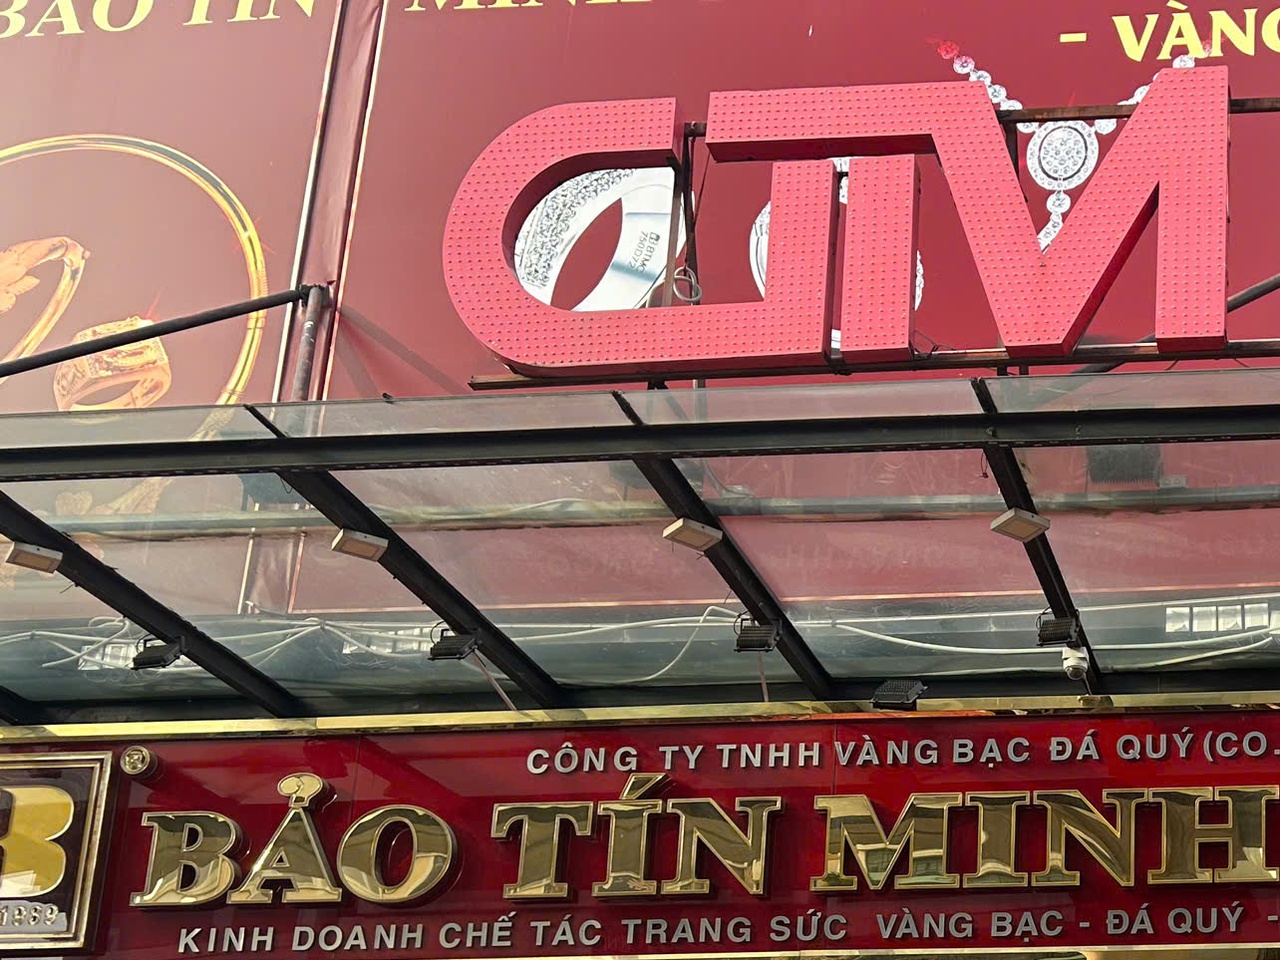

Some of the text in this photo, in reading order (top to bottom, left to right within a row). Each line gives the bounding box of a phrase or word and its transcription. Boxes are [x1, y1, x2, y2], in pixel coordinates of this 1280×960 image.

[526, 741, 639, 774] CÔNG
[659, 744, 704, 771] TY
[716, 741, 821, 769] TNHH
[835, 733, 939, 766] VÀNG
[953, 736, 1030, 769] BẠC
[1050, 729, 1100, 761] ĐÁ
[129, 772, 458, 908] BẢO
[490, 771, 783, 900] TÍN
[809, 784, 1280, 893] MINH
[178, 925, 274, 953] KINH
[292, 922, 424, 951] DOANH
[439, 911, 516, 948] CHẾ
[530, 914, 602, 945] TÁC
[622, 916, 753, 944] TRANG
[770, 908, 847, 941] SỨC
[877, 906, 975, 939] VÀNG
[991, 909, 1064, 942] BẠC
[1107, 902, 1154, 935] ĐÁ
[1168, 900, 1245, 934] QUÝ
